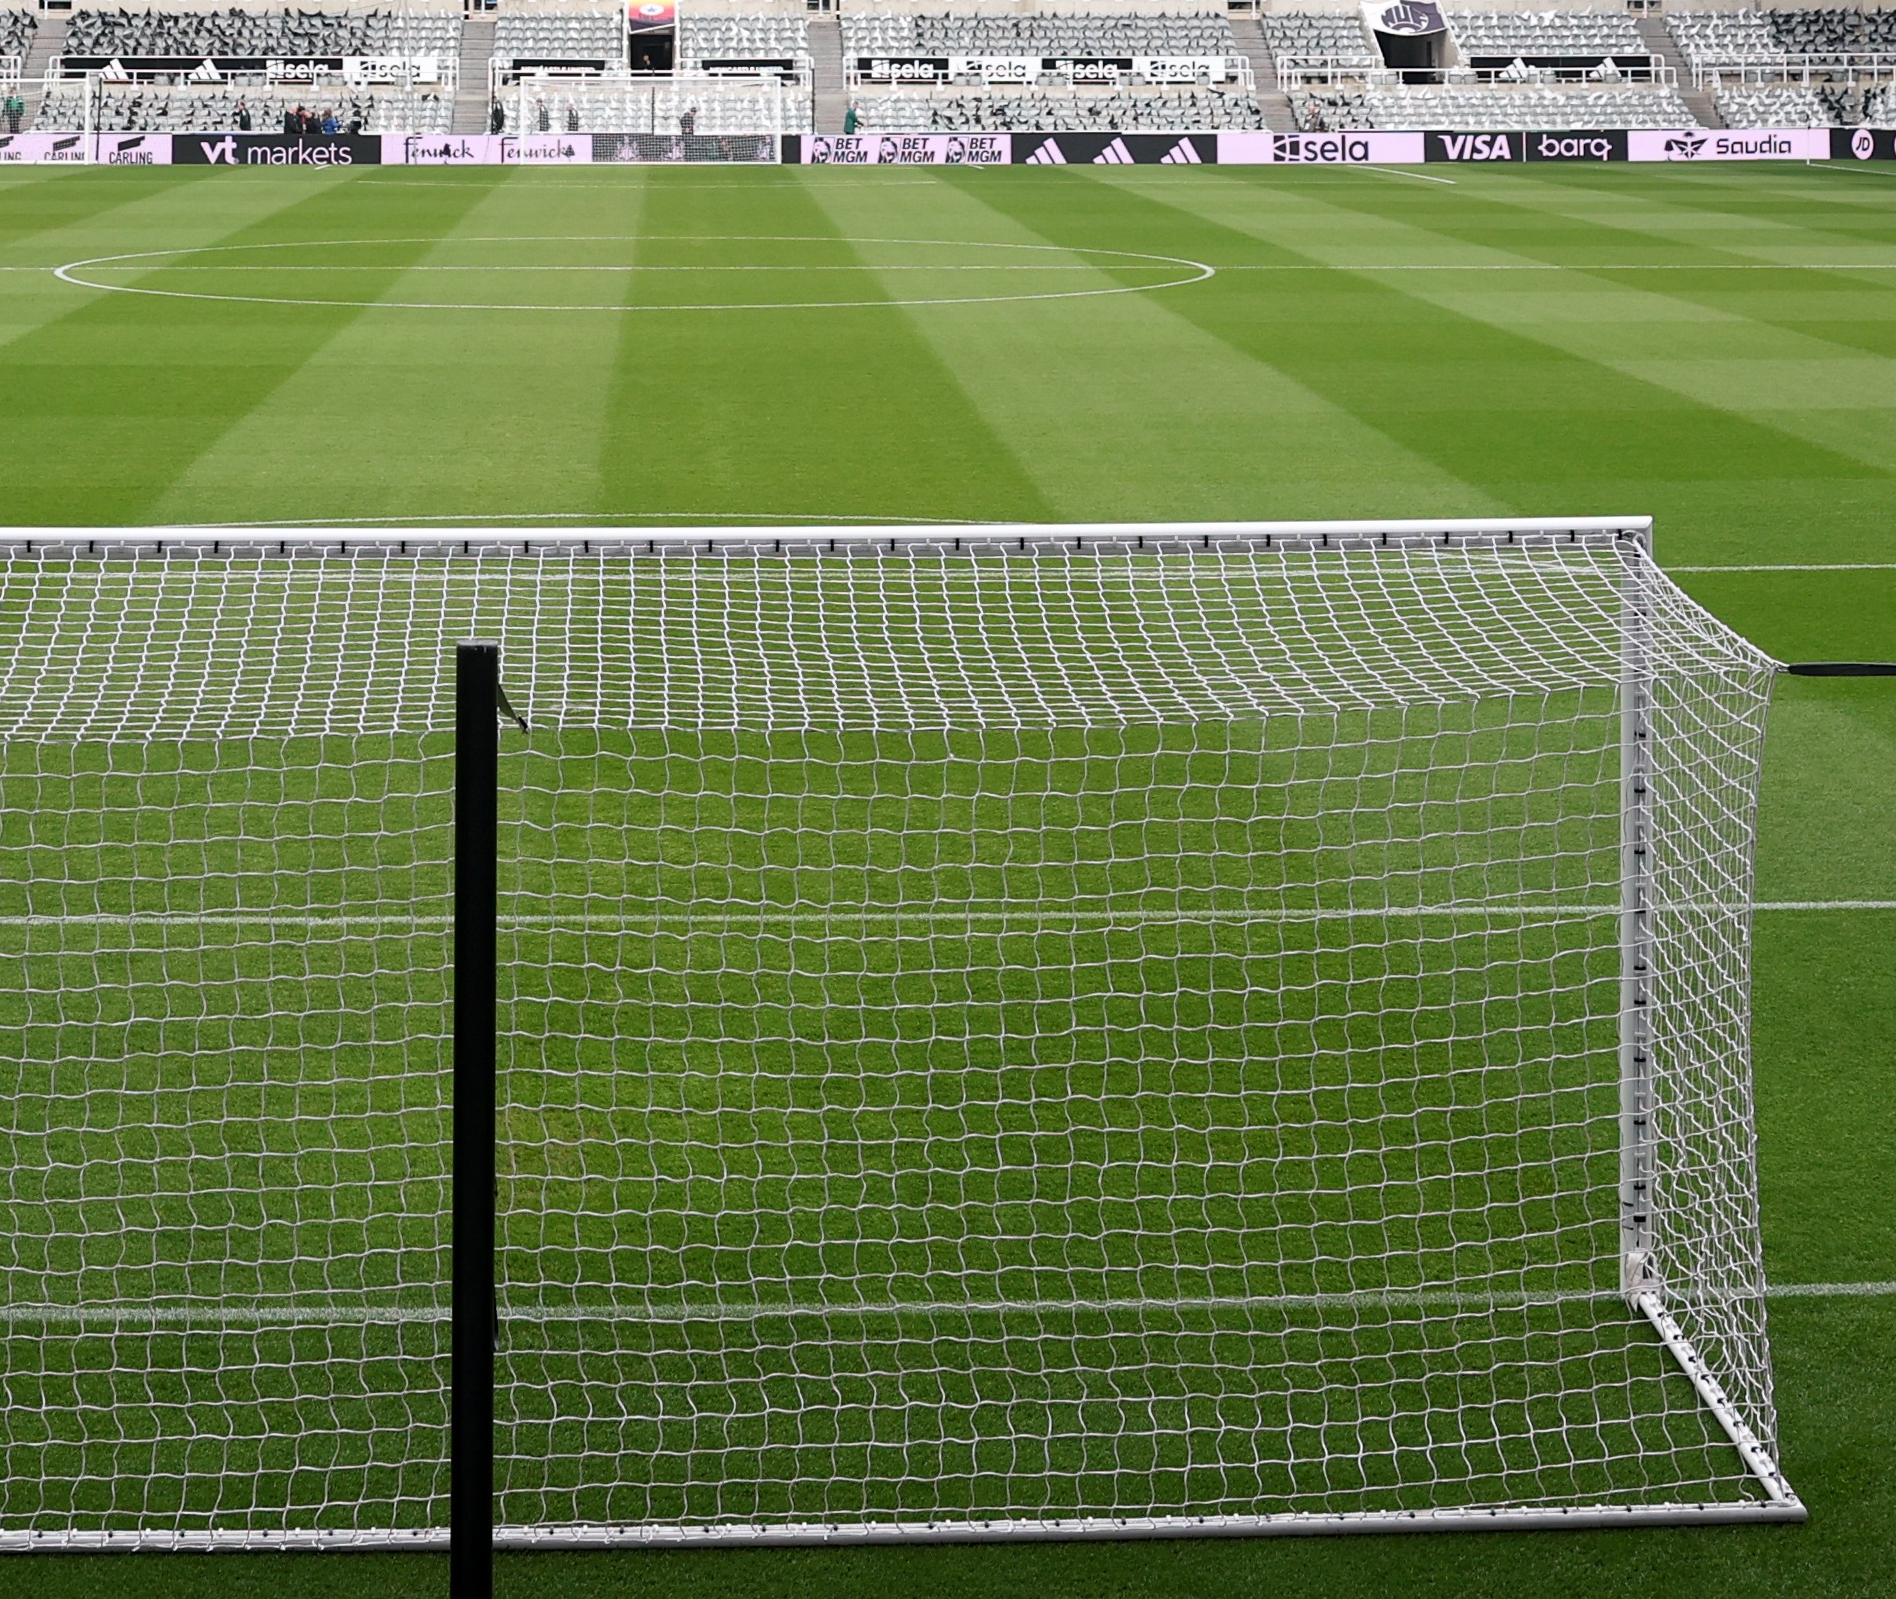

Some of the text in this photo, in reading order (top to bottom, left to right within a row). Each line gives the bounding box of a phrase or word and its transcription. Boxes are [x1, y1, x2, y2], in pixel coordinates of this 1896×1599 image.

[835, 137, 863, 150] BET
[902, 137, 930, 150] BET
[969, 137, 997, 150] BET
[1304, 134, 1369, 162] sela
[1437, 134, 1511, 160] VISA
[1538, 134, 1612, 161] barq
[1716, 134, 1792, 155] Saudia
[1855, 139, 1870, 152] JD
[200, 136, 353, 165] vt markets
[833, 151, 868, 163] MGM
[900, 151, 935, 163] MGM
[967, 151, 1002, 163] MGM
[109, 151, 153, 165] CARLING
